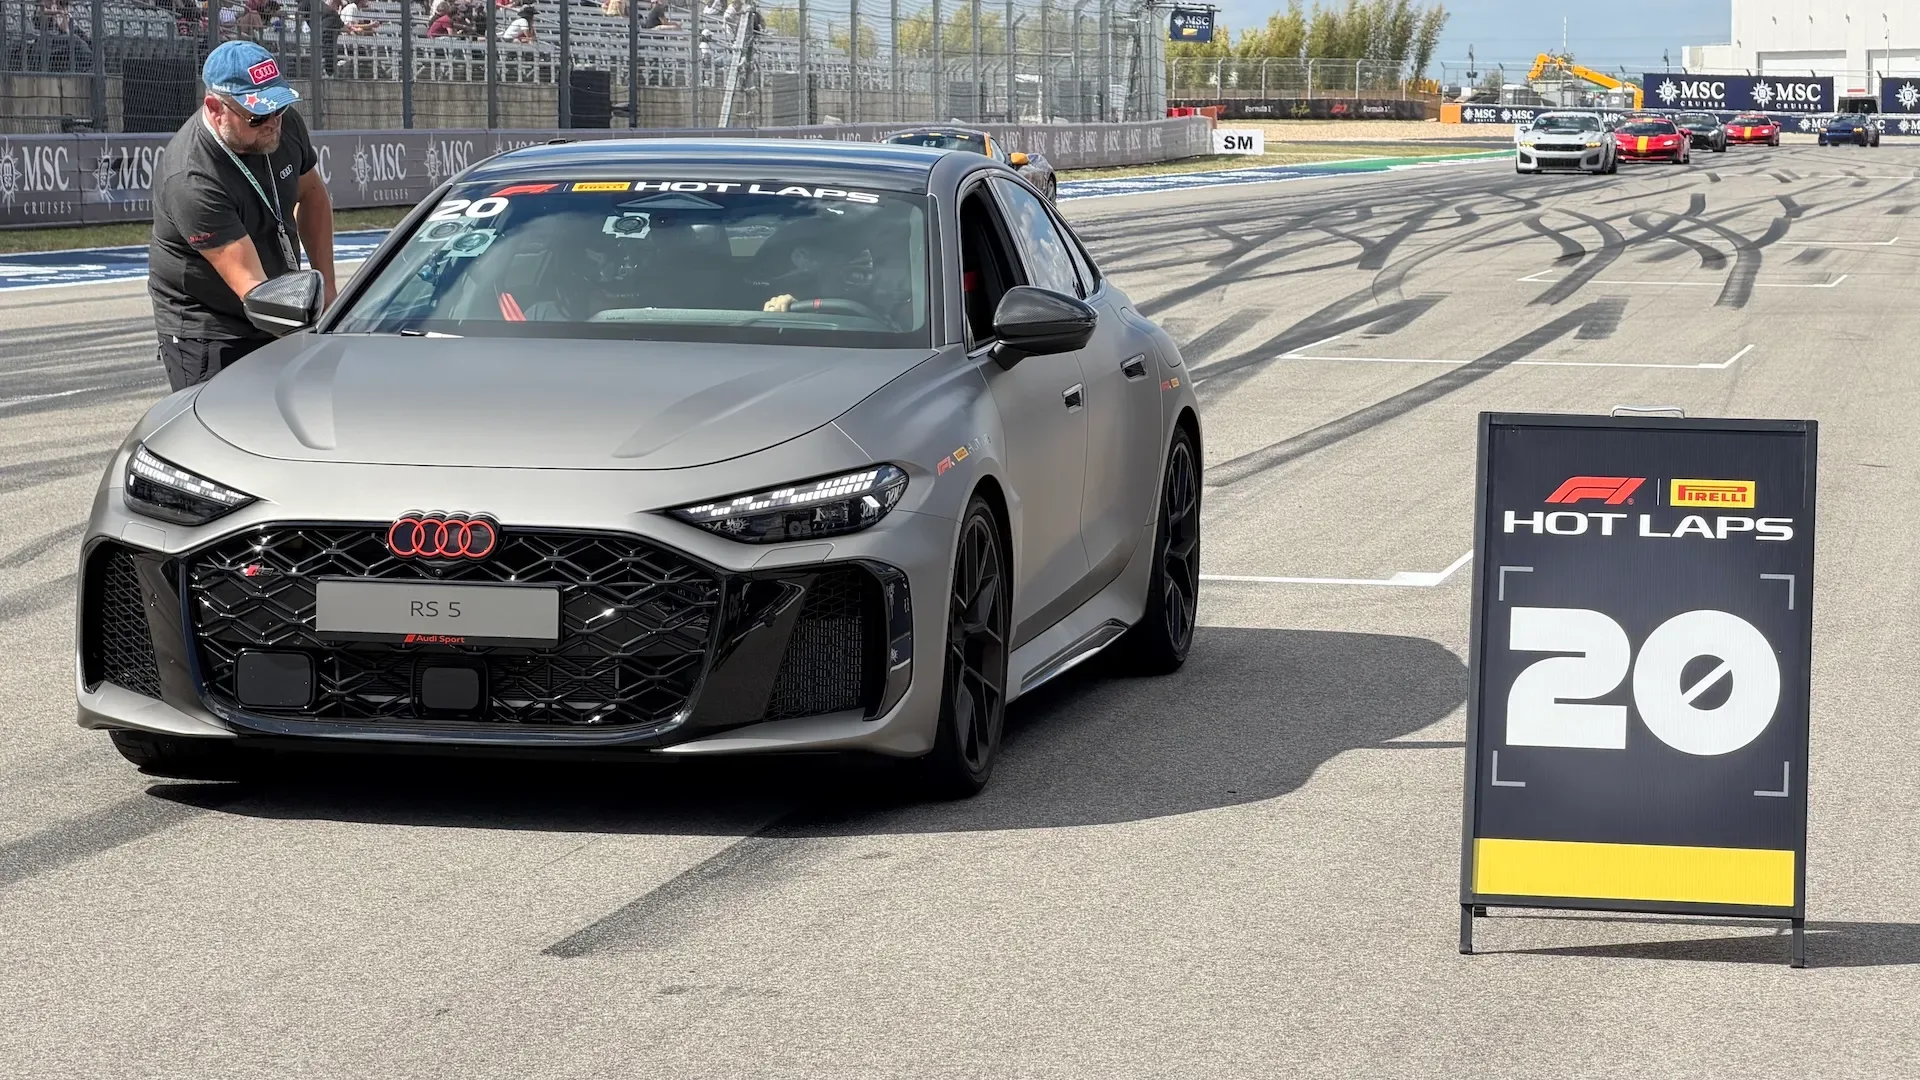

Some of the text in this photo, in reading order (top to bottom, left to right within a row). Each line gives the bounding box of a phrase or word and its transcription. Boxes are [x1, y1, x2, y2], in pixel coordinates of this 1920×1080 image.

[1186, 15, 1209, 25] MSC
[1680, 82, 1725, 99] MSC
[1775, 83, 1821, 101] MSC
[1474, 109, 1496, 118] MSC
[1512, 110, 1534, 119] MSC
[1224, 135, 1253, 150] SM
[22, 146, 69, 191] MSC
[371, 143, 406, 181] MSC
[373, 188, 408, 201] CRUISES
[634, 182, 741, 193] HOT
[749, 184, 880, 204] LAPS
[24, 200, 72, 215] CRUISES
[123, 198, 150, 212] CRUI
[428, 196, 509, 222] 20
[1545, 476, 1747, 504] F1 PIRELLI
[1504, 511, 1793, 540] HOT LAPS
[411, 601, 461, 617] RS 5
[1506, 607, 1780, 756] 20
